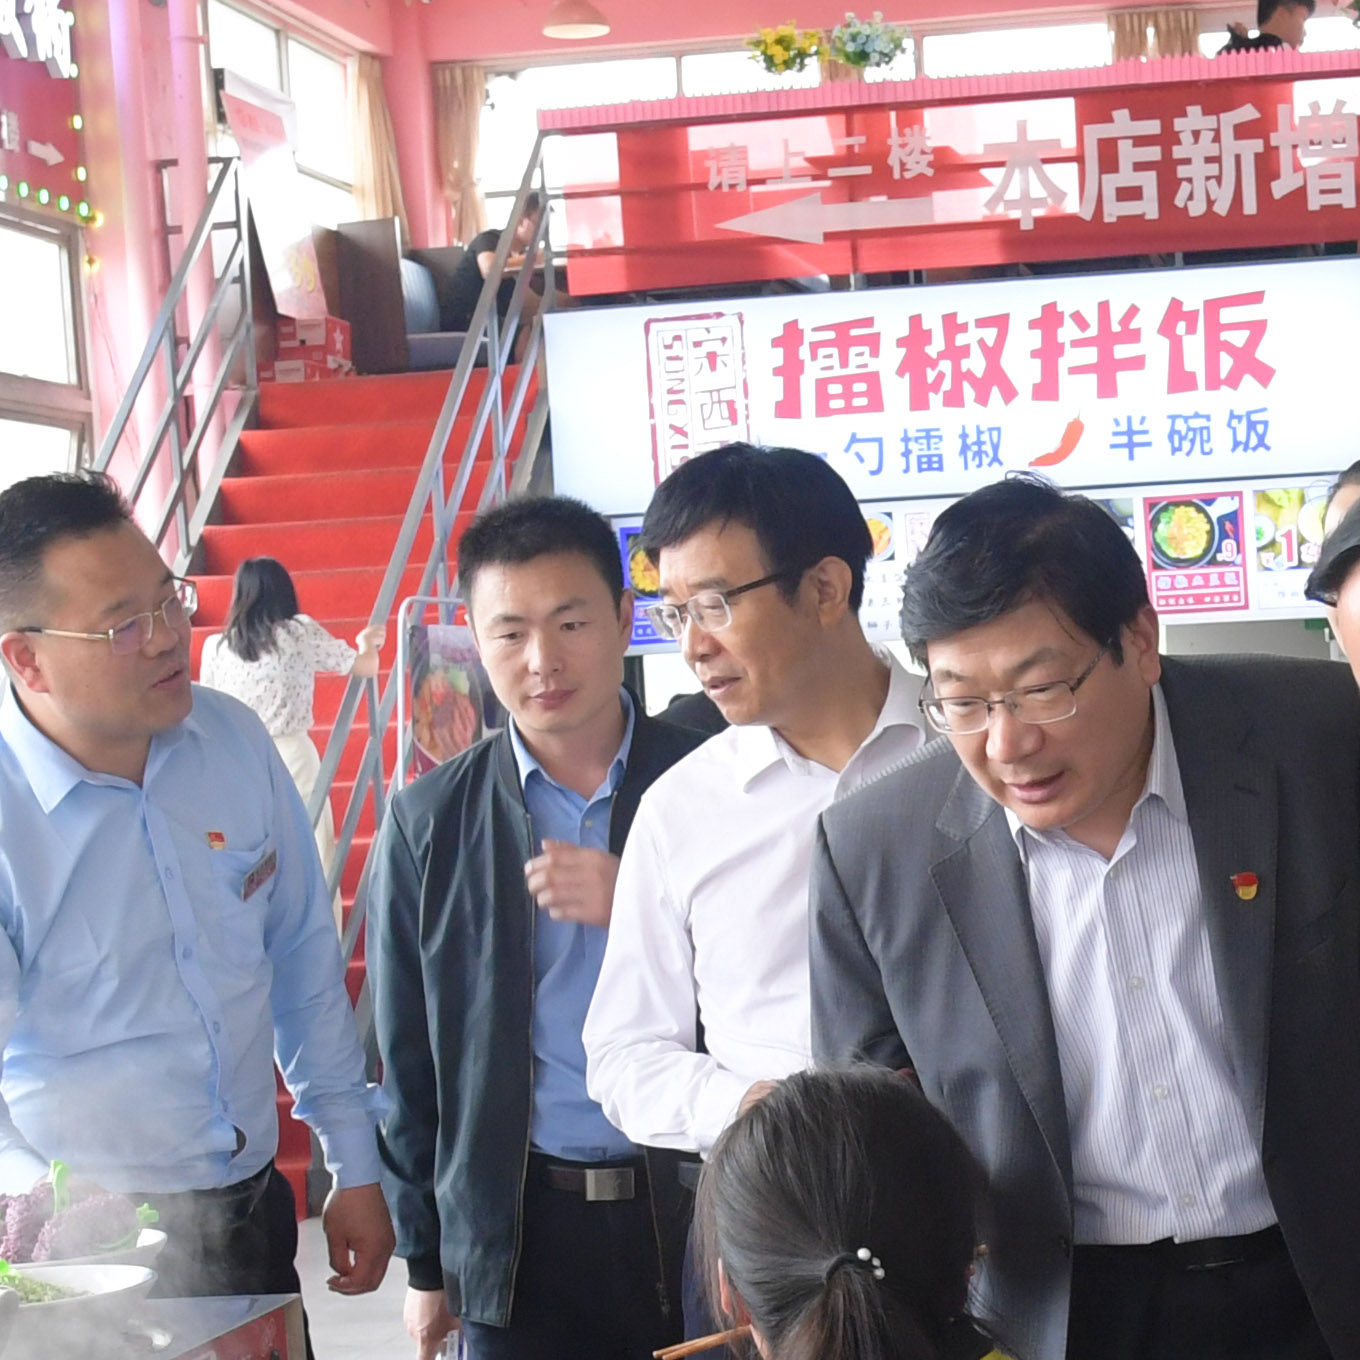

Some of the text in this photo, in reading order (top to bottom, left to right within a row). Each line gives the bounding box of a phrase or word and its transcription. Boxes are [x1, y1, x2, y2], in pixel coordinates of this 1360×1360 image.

[704, 124, 937, 194] 请上二楼
[692, 327, 739, 452] 宋西
[770, 289, 1277, 421] 擂椒拌饭
[1108, 406, 1273, 463] 半碗饭
